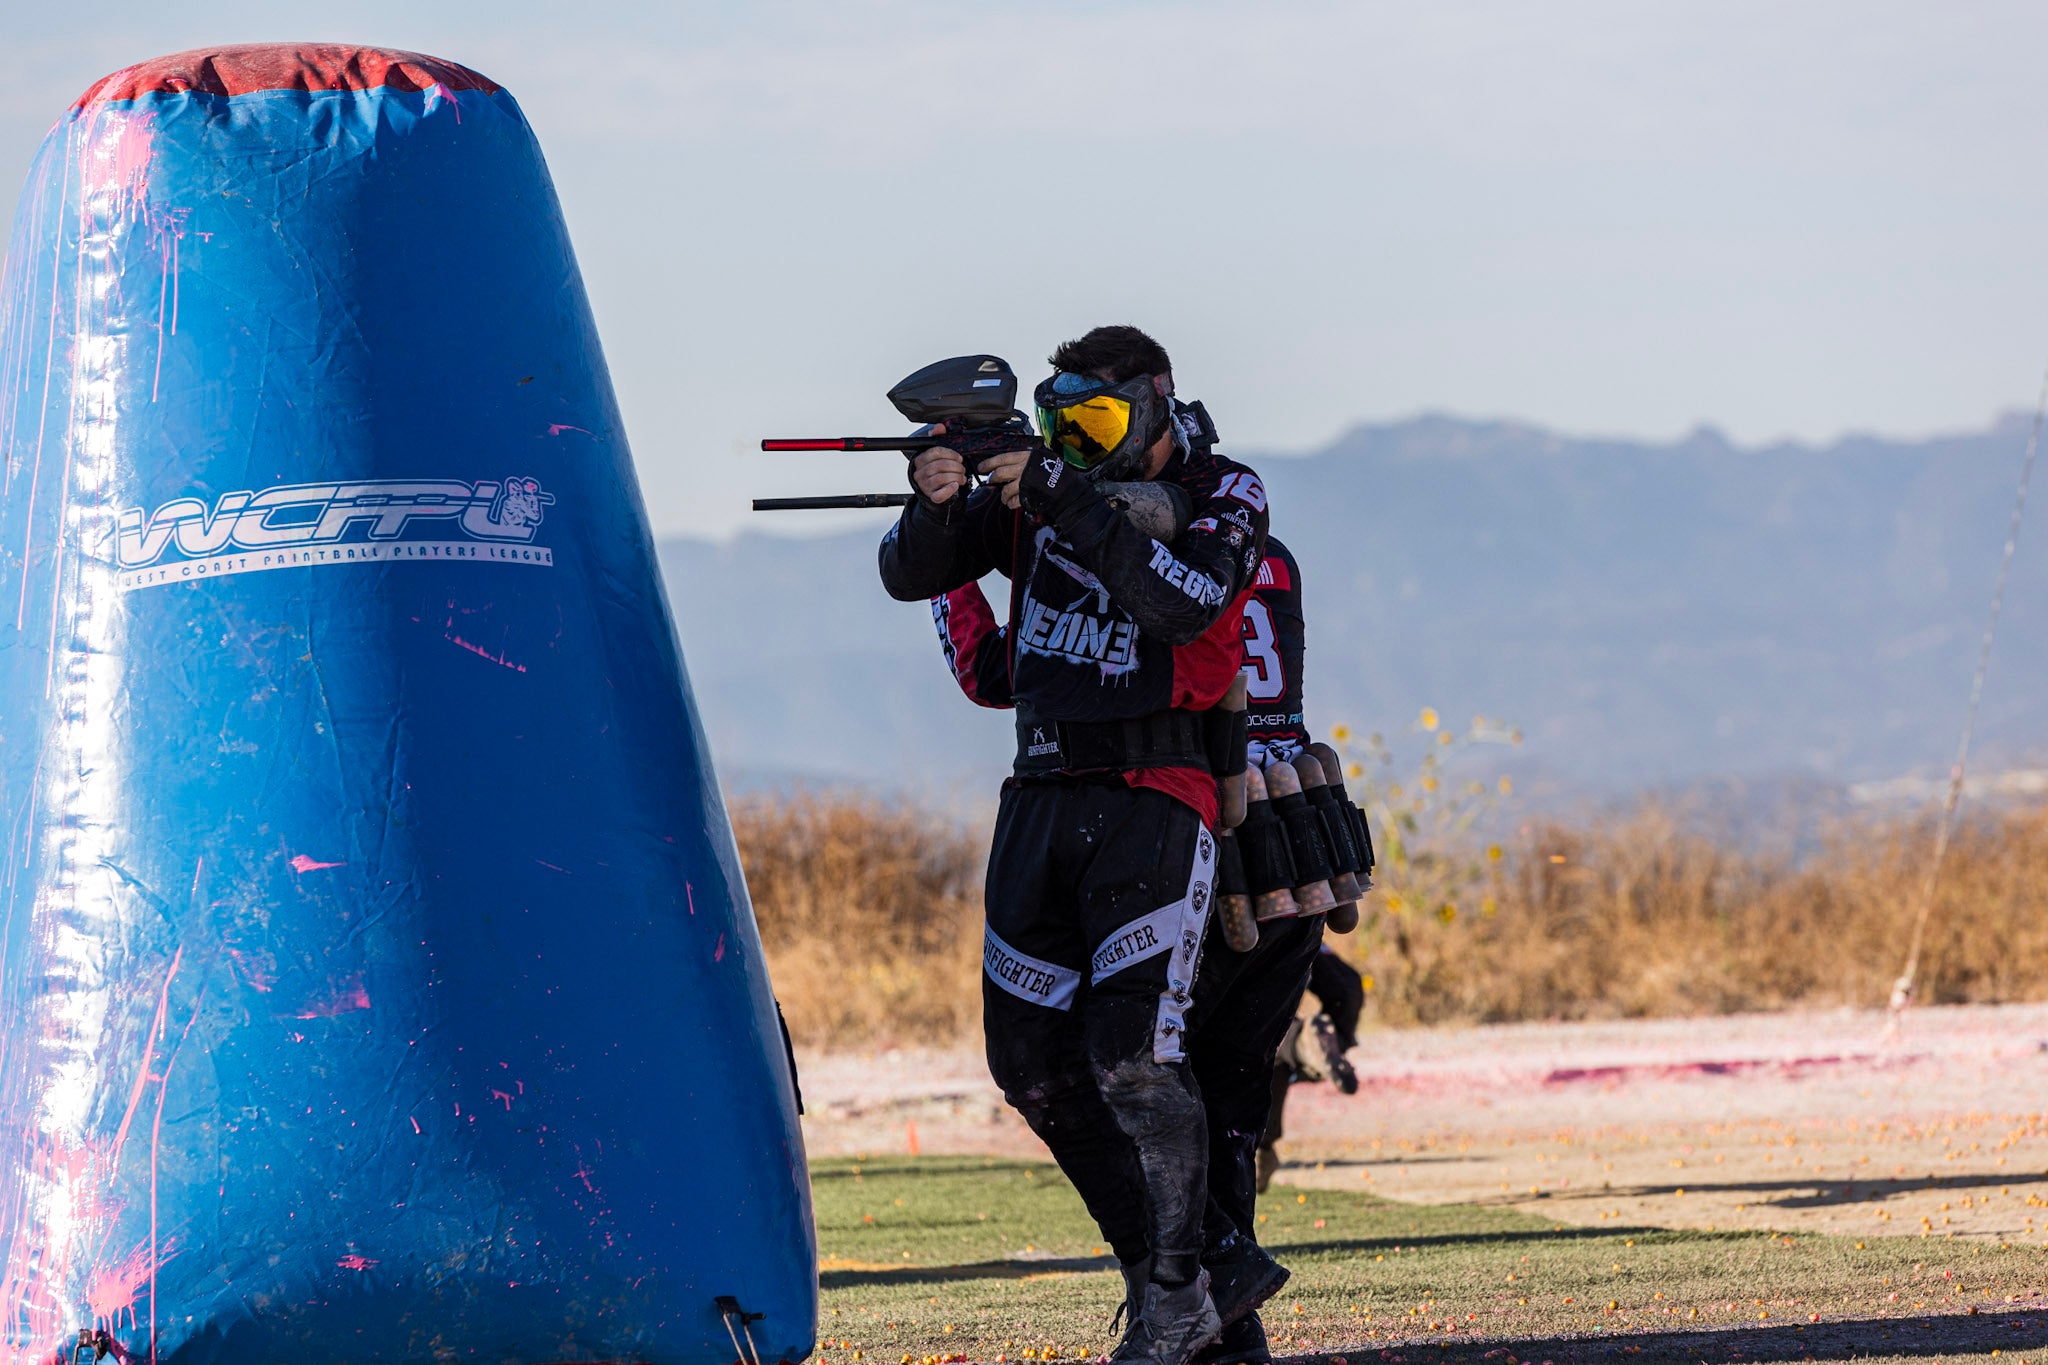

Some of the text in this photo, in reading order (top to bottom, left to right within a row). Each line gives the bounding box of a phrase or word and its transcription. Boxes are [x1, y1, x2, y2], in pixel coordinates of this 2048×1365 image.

[181, 558, 247, 576] COAST
[264, 547, 378, 565] PAINTBALL
[394, 546, 476, 557] PLAYERS
[490, 548, 551, 562] LEAGUE
